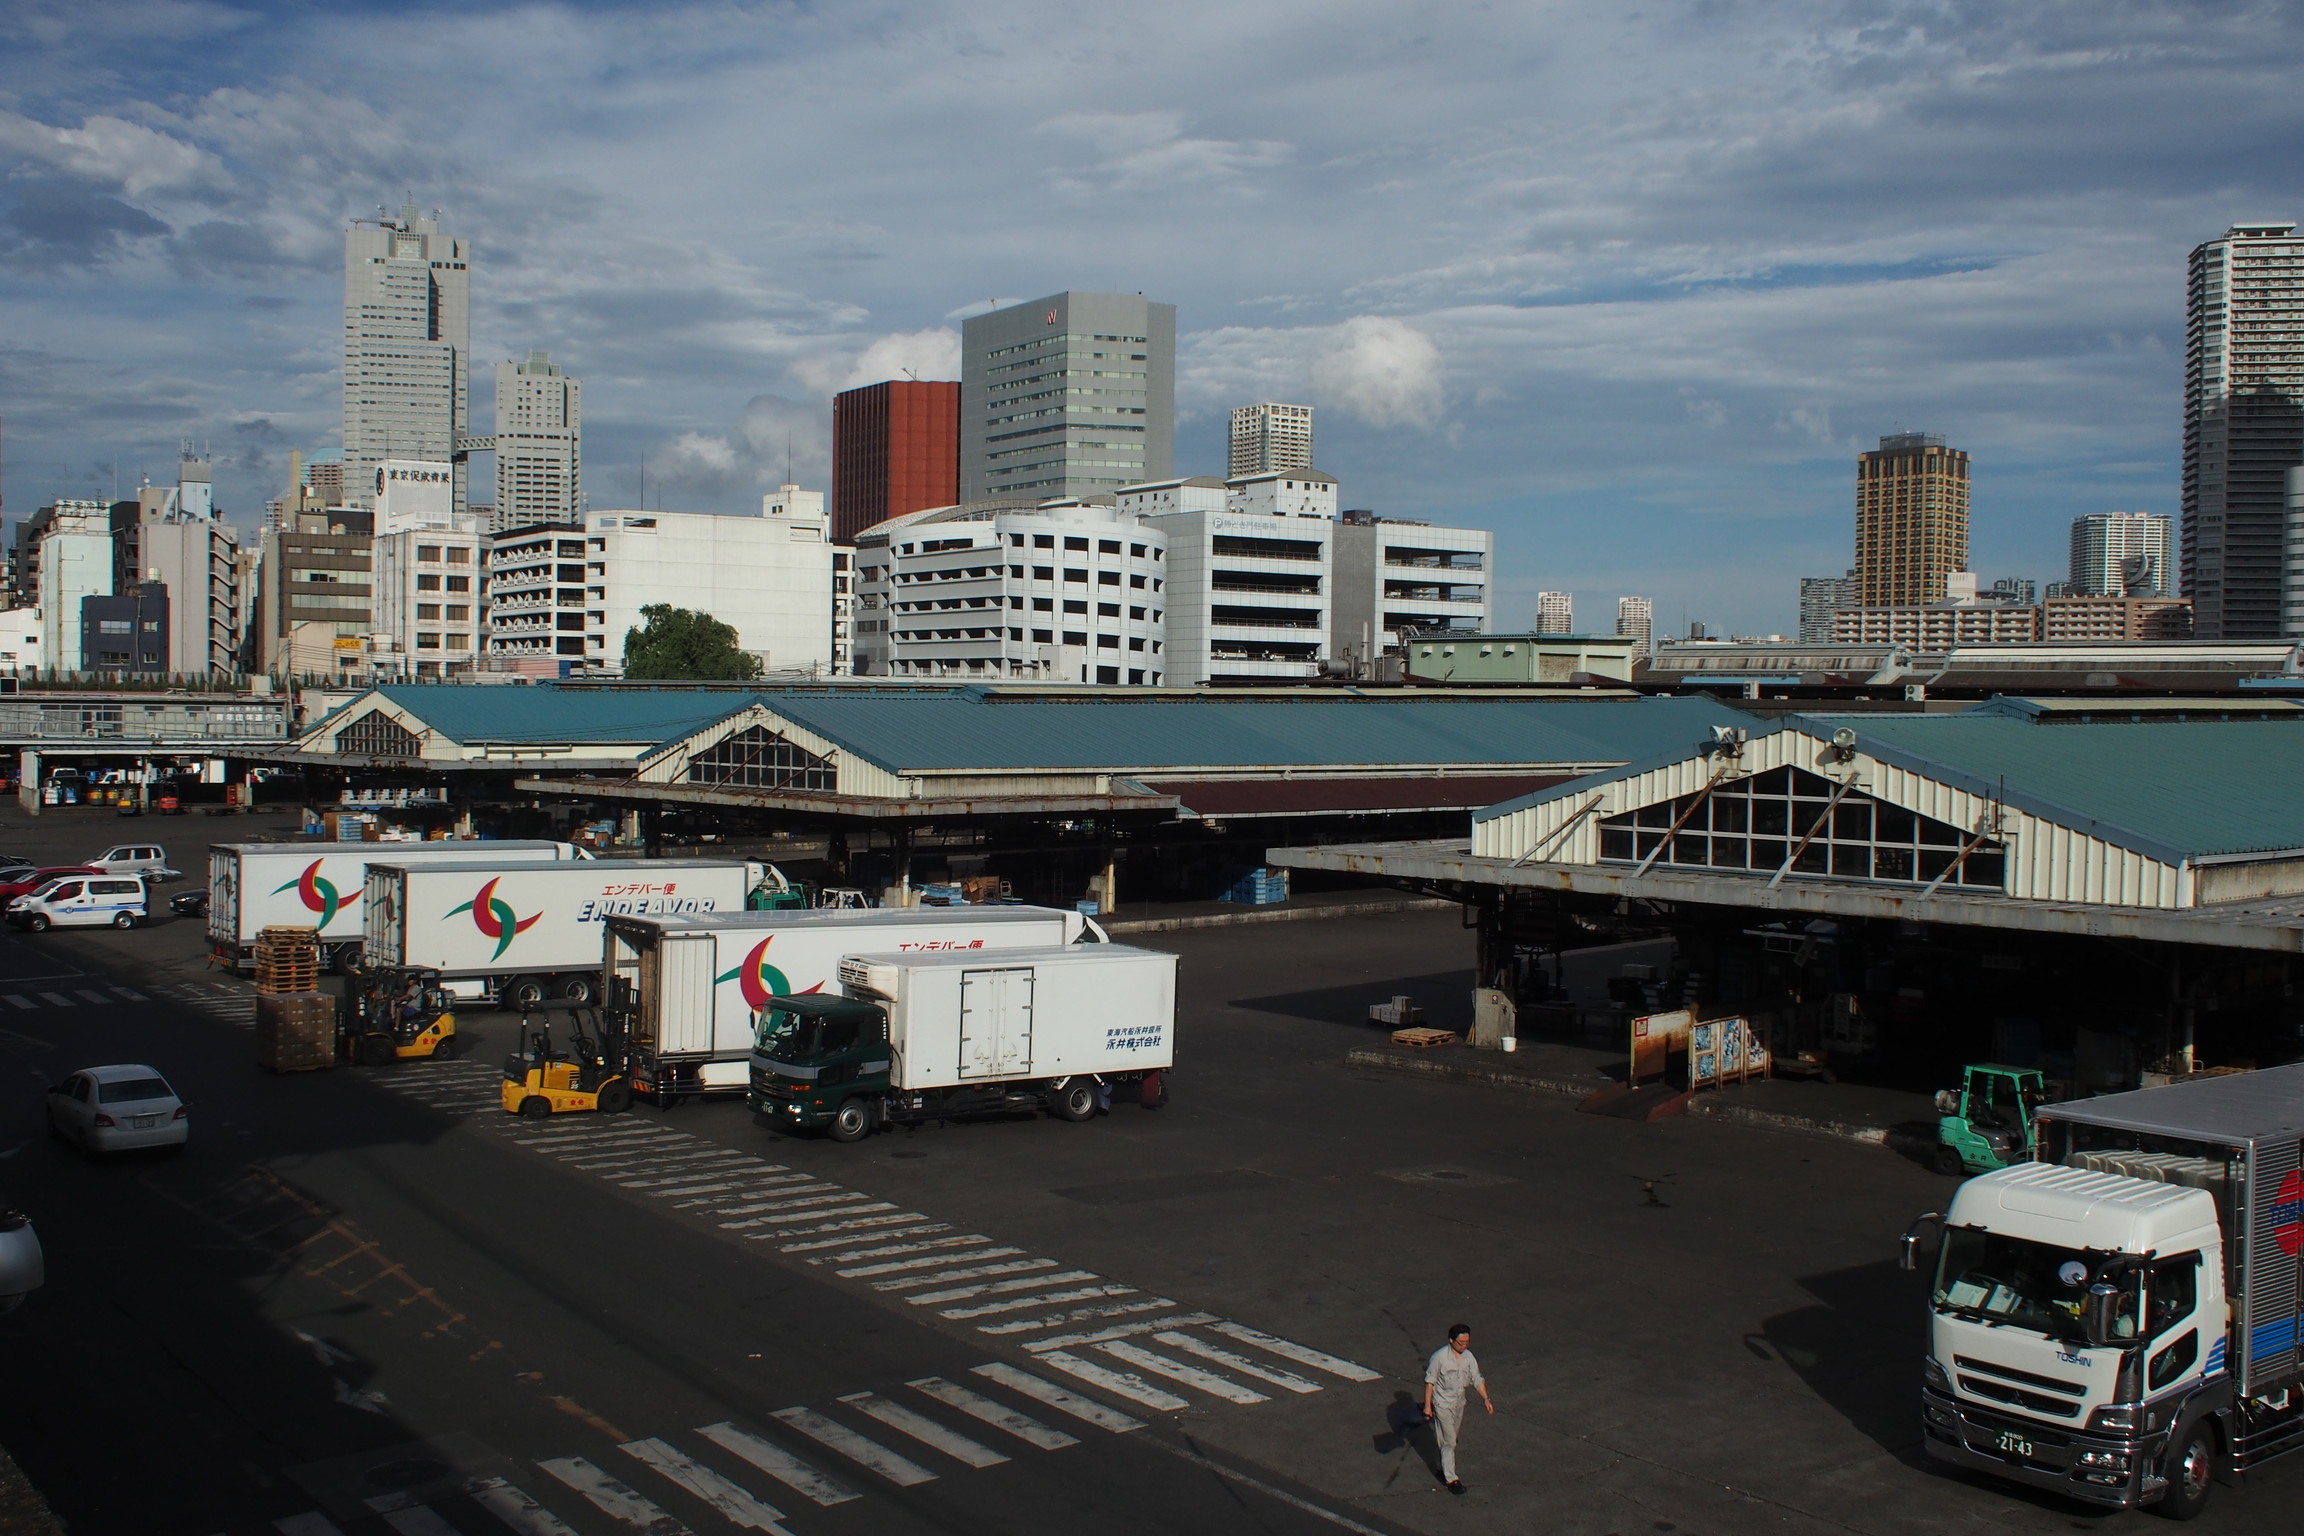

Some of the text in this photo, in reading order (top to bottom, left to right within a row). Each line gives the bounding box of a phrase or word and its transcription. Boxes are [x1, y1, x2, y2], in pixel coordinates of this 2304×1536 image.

[389, 468, 450, 484] 東京促成青果
[601, 883, 676, 895] エンデバー便
[576, 897, 716, 922] ENDEAVOR
[1106, 1036, 1162, 1050] 永井株式会社
[2055, 1351, 2092, 1367] TOSHIN
[2000, 1436, 2033, 1456] 21-43
